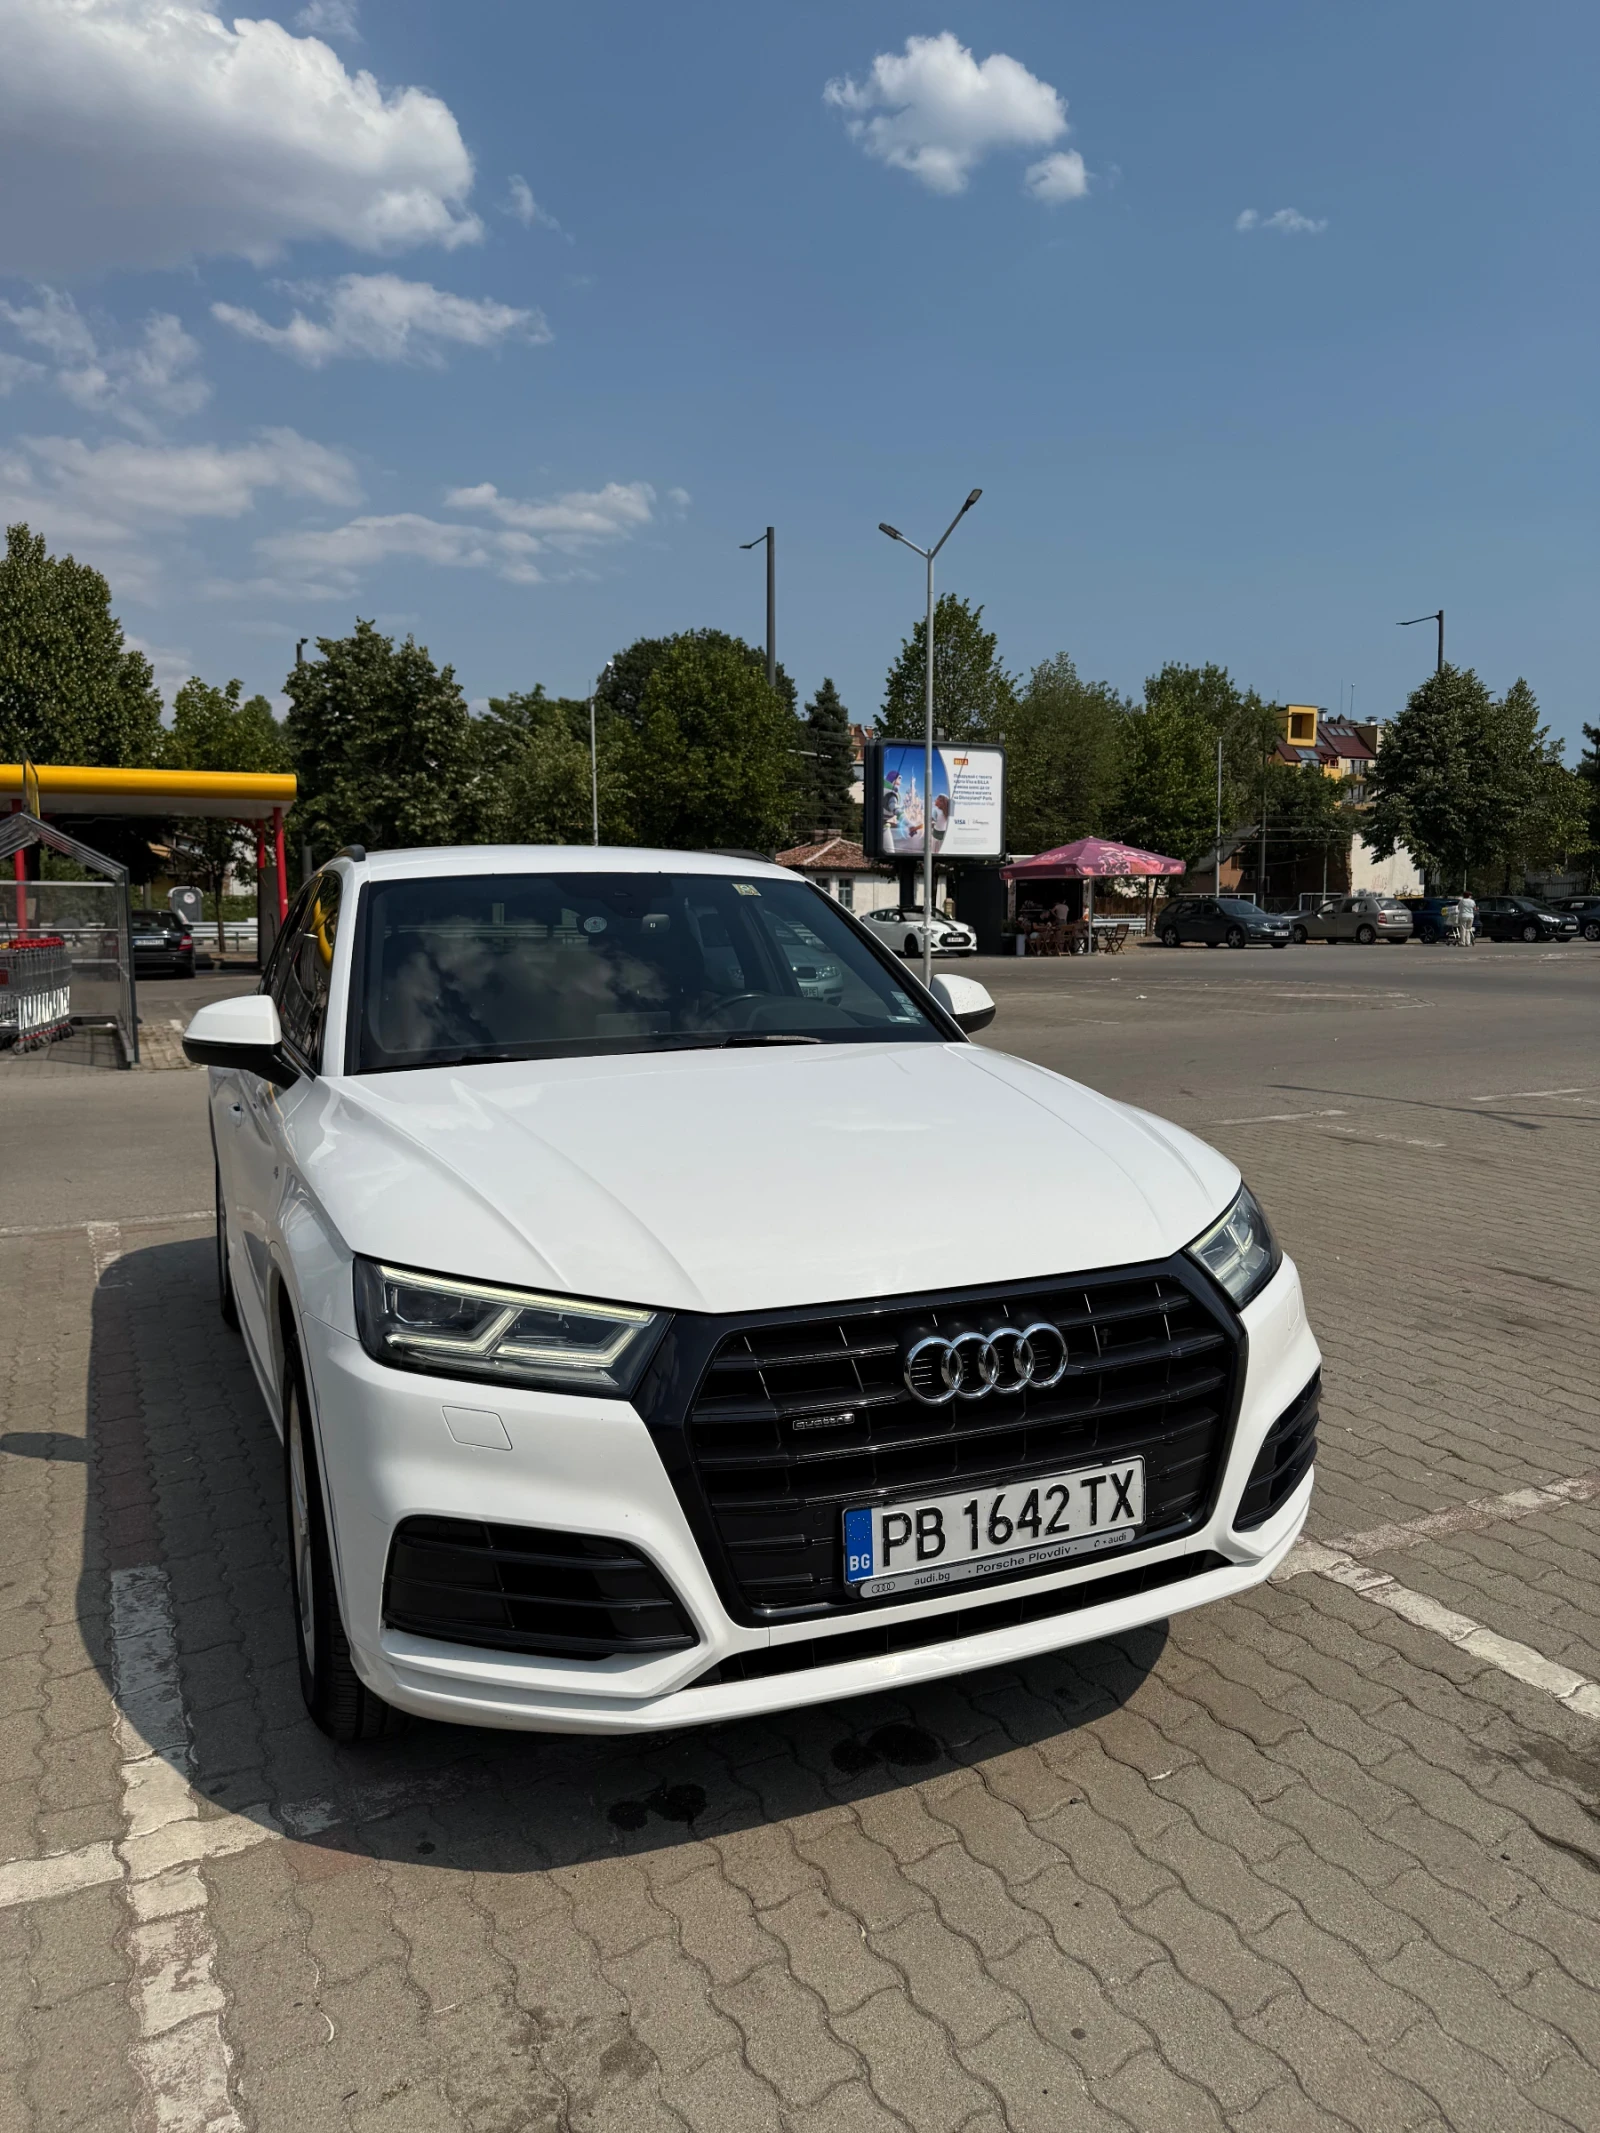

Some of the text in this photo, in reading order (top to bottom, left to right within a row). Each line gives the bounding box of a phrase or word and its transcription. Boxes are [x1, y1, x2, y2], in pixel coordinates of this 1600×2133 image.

[796, 1416, 852, 1429] quattro
[882, 1469, 1136, 1567] PB 1642 TX
[849, 1554, 870, 1571] BG
[914, 1572, 950, 1585] audi.bg
[976, 1556, 1024, 1574] Porsche
[1029, 1546, 1071, 1563] Plovdiv
